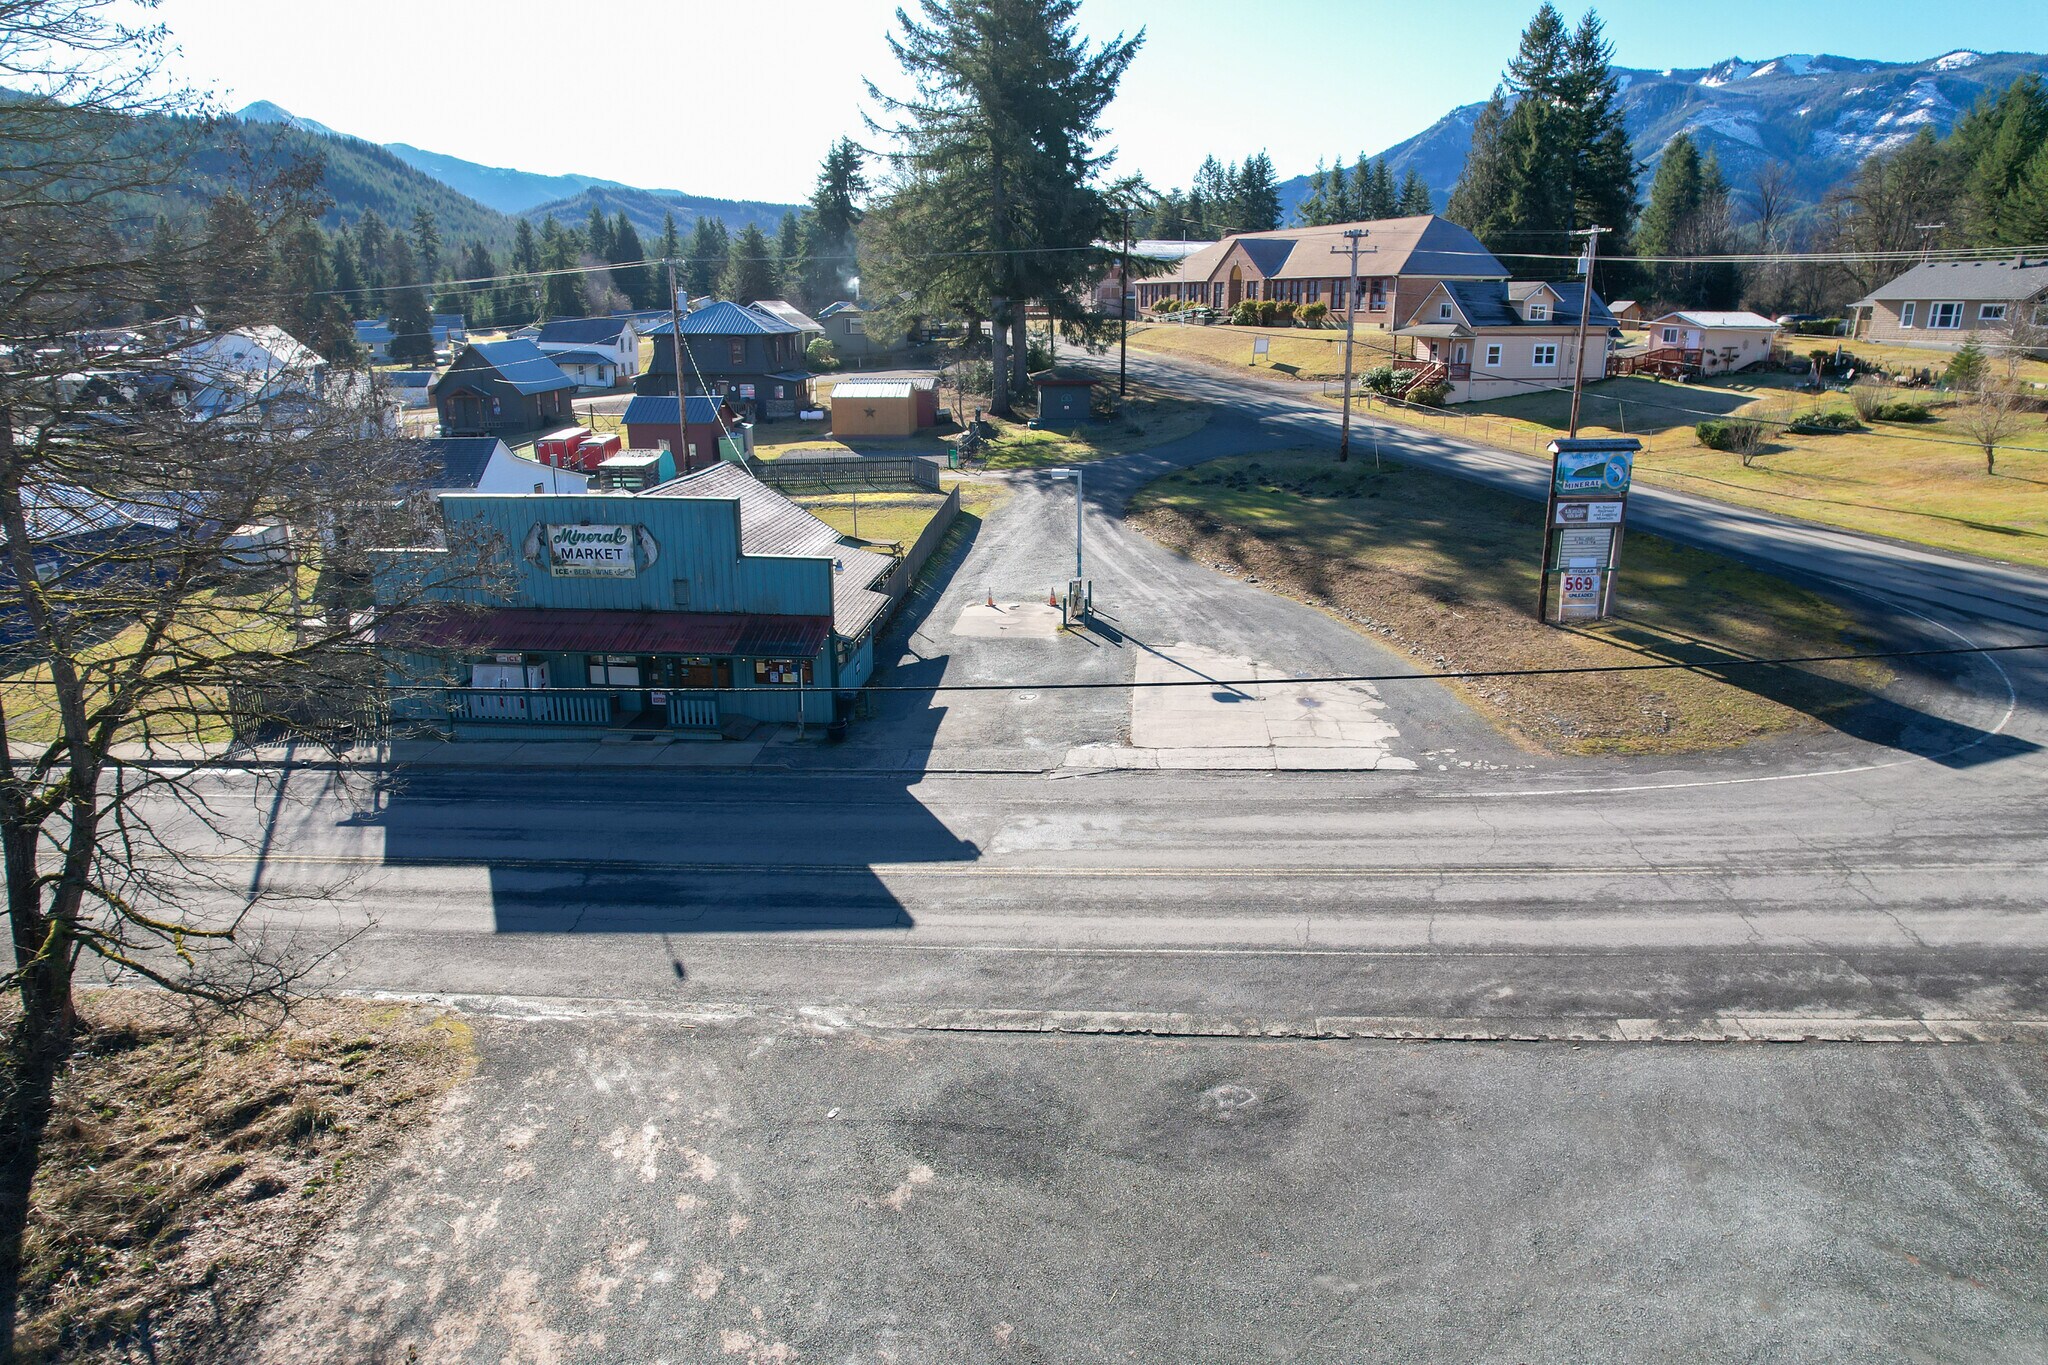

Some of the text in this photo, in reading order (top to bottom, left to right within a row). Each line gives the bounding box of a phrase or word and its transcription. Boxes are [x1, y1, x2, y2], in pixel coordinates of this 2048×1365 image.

[1565, 480, 1600, 489] MINERAL
[553, 527, 628, 546] Mineral
[561, 548, 623, 560] MARKET
[574, 568, 592, 576] BEER
[595, 568, 614, 576] WINE
[1565, 577, 1593, 591] 569
